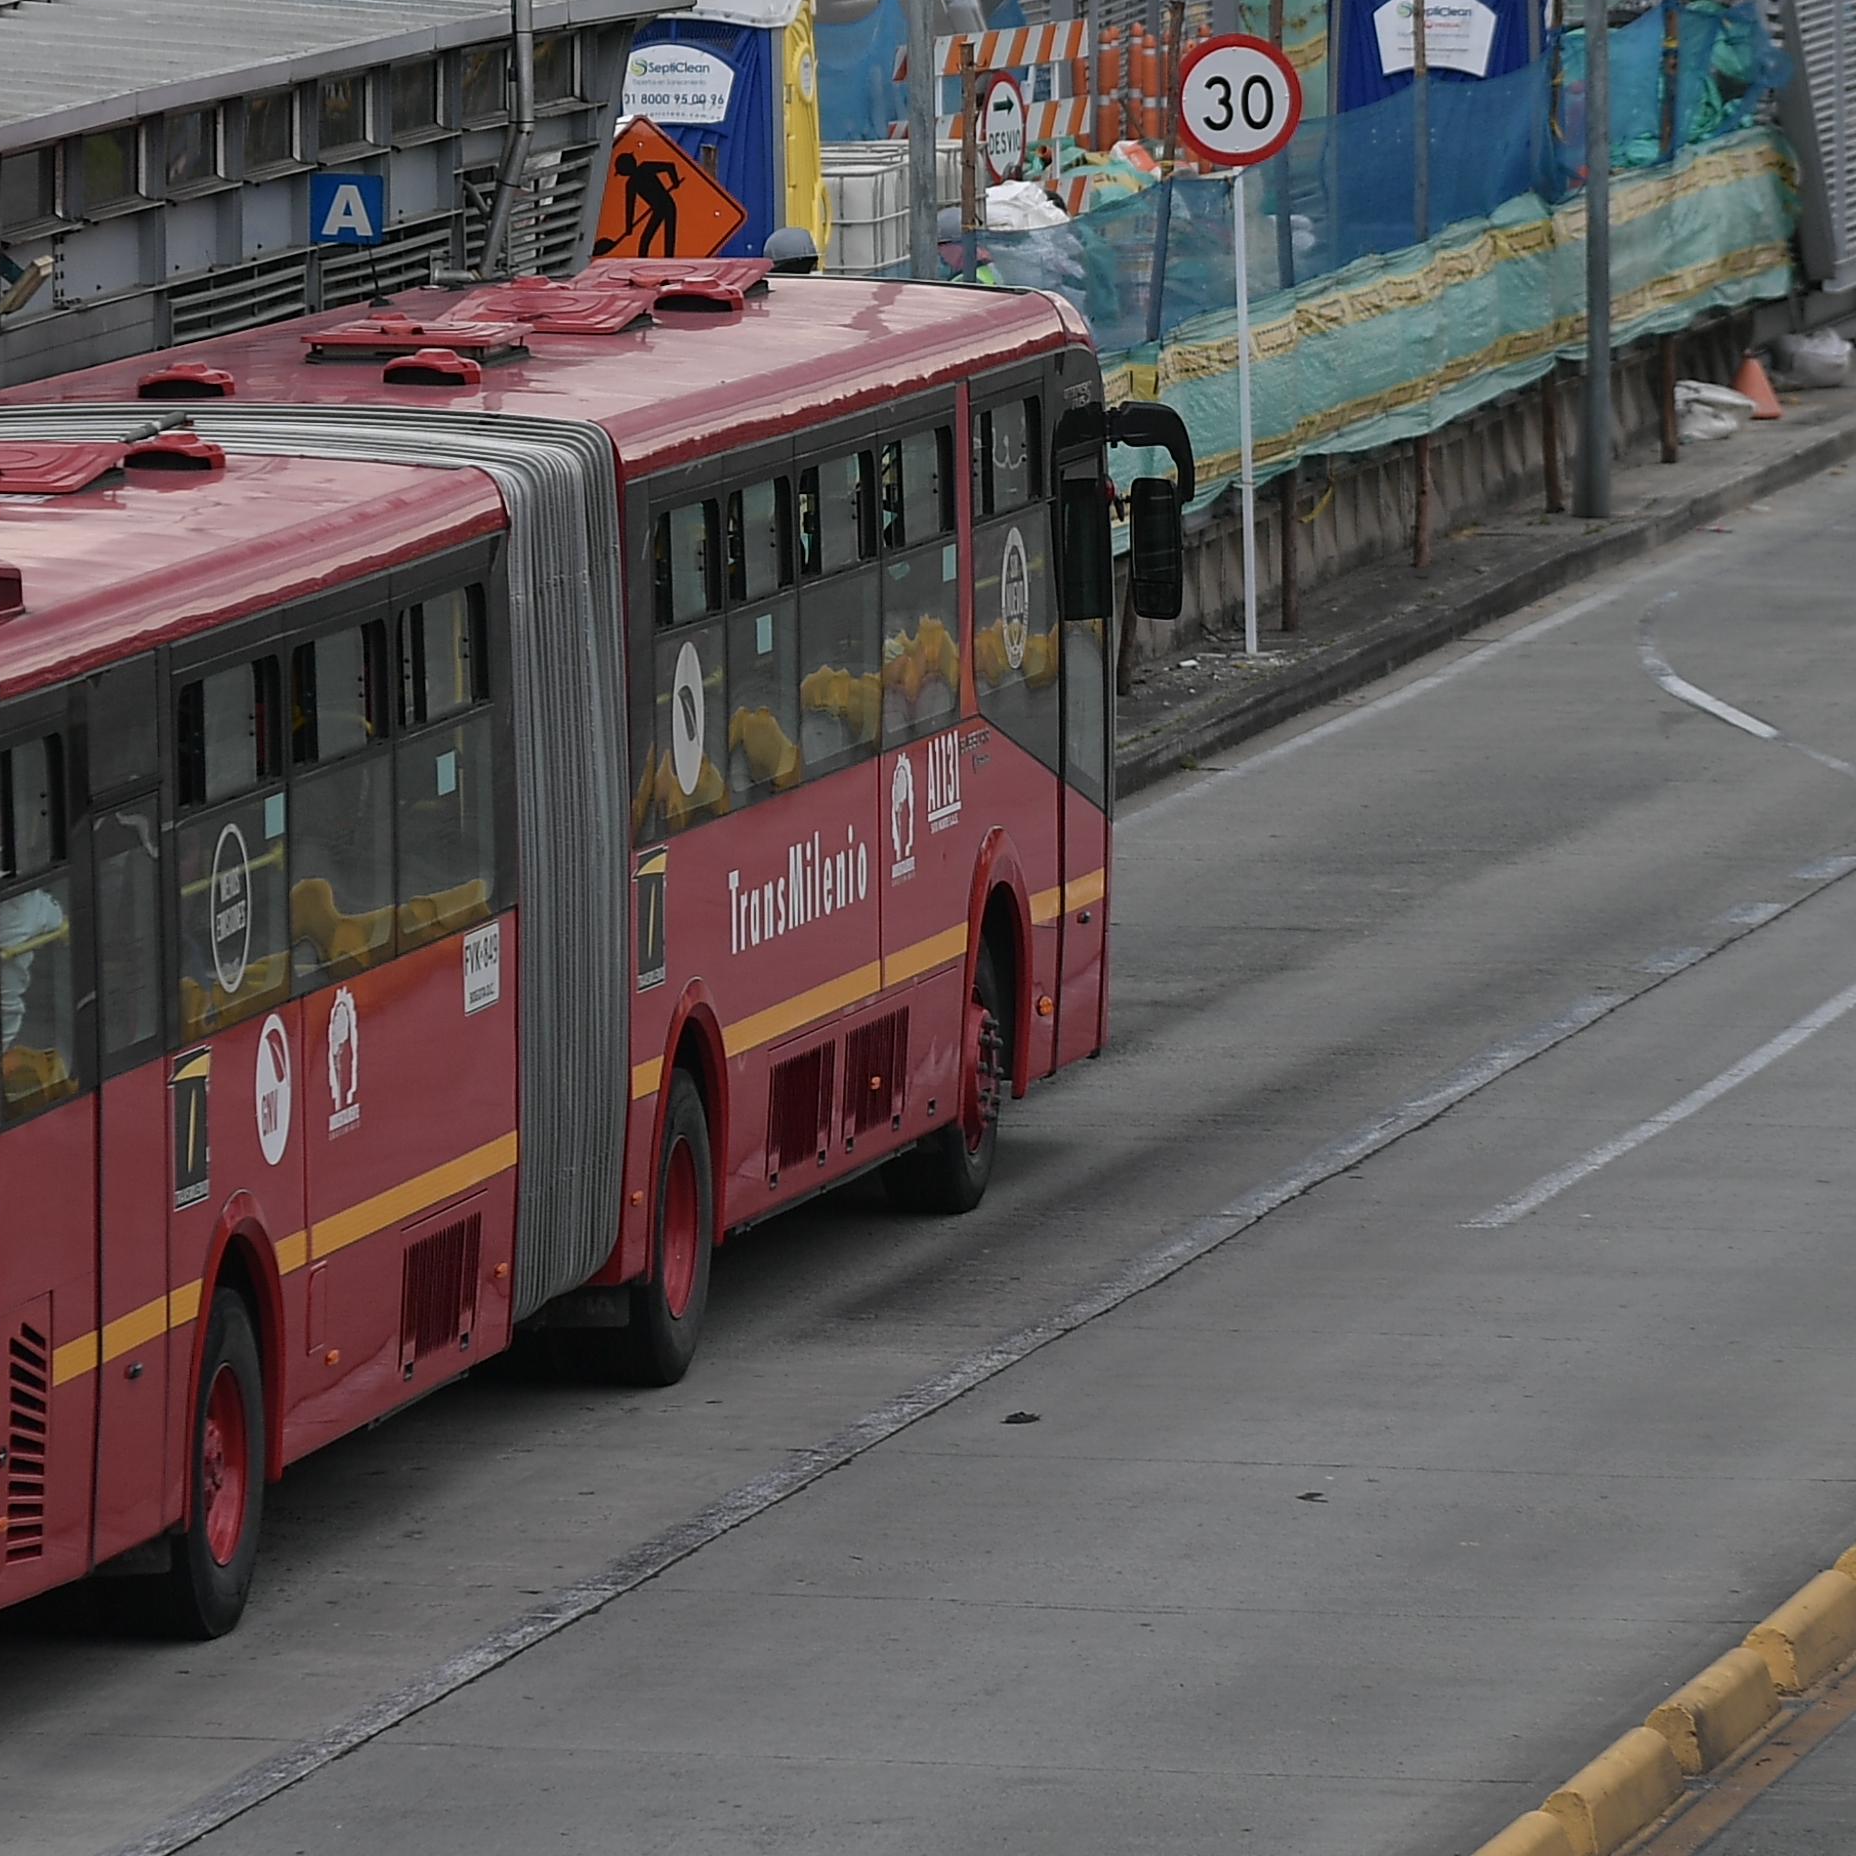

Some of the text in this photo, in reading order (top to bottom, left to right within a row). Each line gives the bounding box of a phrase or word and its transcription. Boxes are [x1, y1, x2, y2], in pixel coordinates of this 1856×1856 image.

[647, 61, 711, 75] SeptiClean
[640, 93, 670, 105] 8000
[674, 93, 688, 105] 95
[691, 93, 707, 105] 00
[1203, 74, 1274, 132] 30
[989, 129, 1022, 156] DESVIO
[321, 184, 374, 236] A
[927, 729, 960, 813] A1131
[728, 823, 868, 955] TransMilenio
